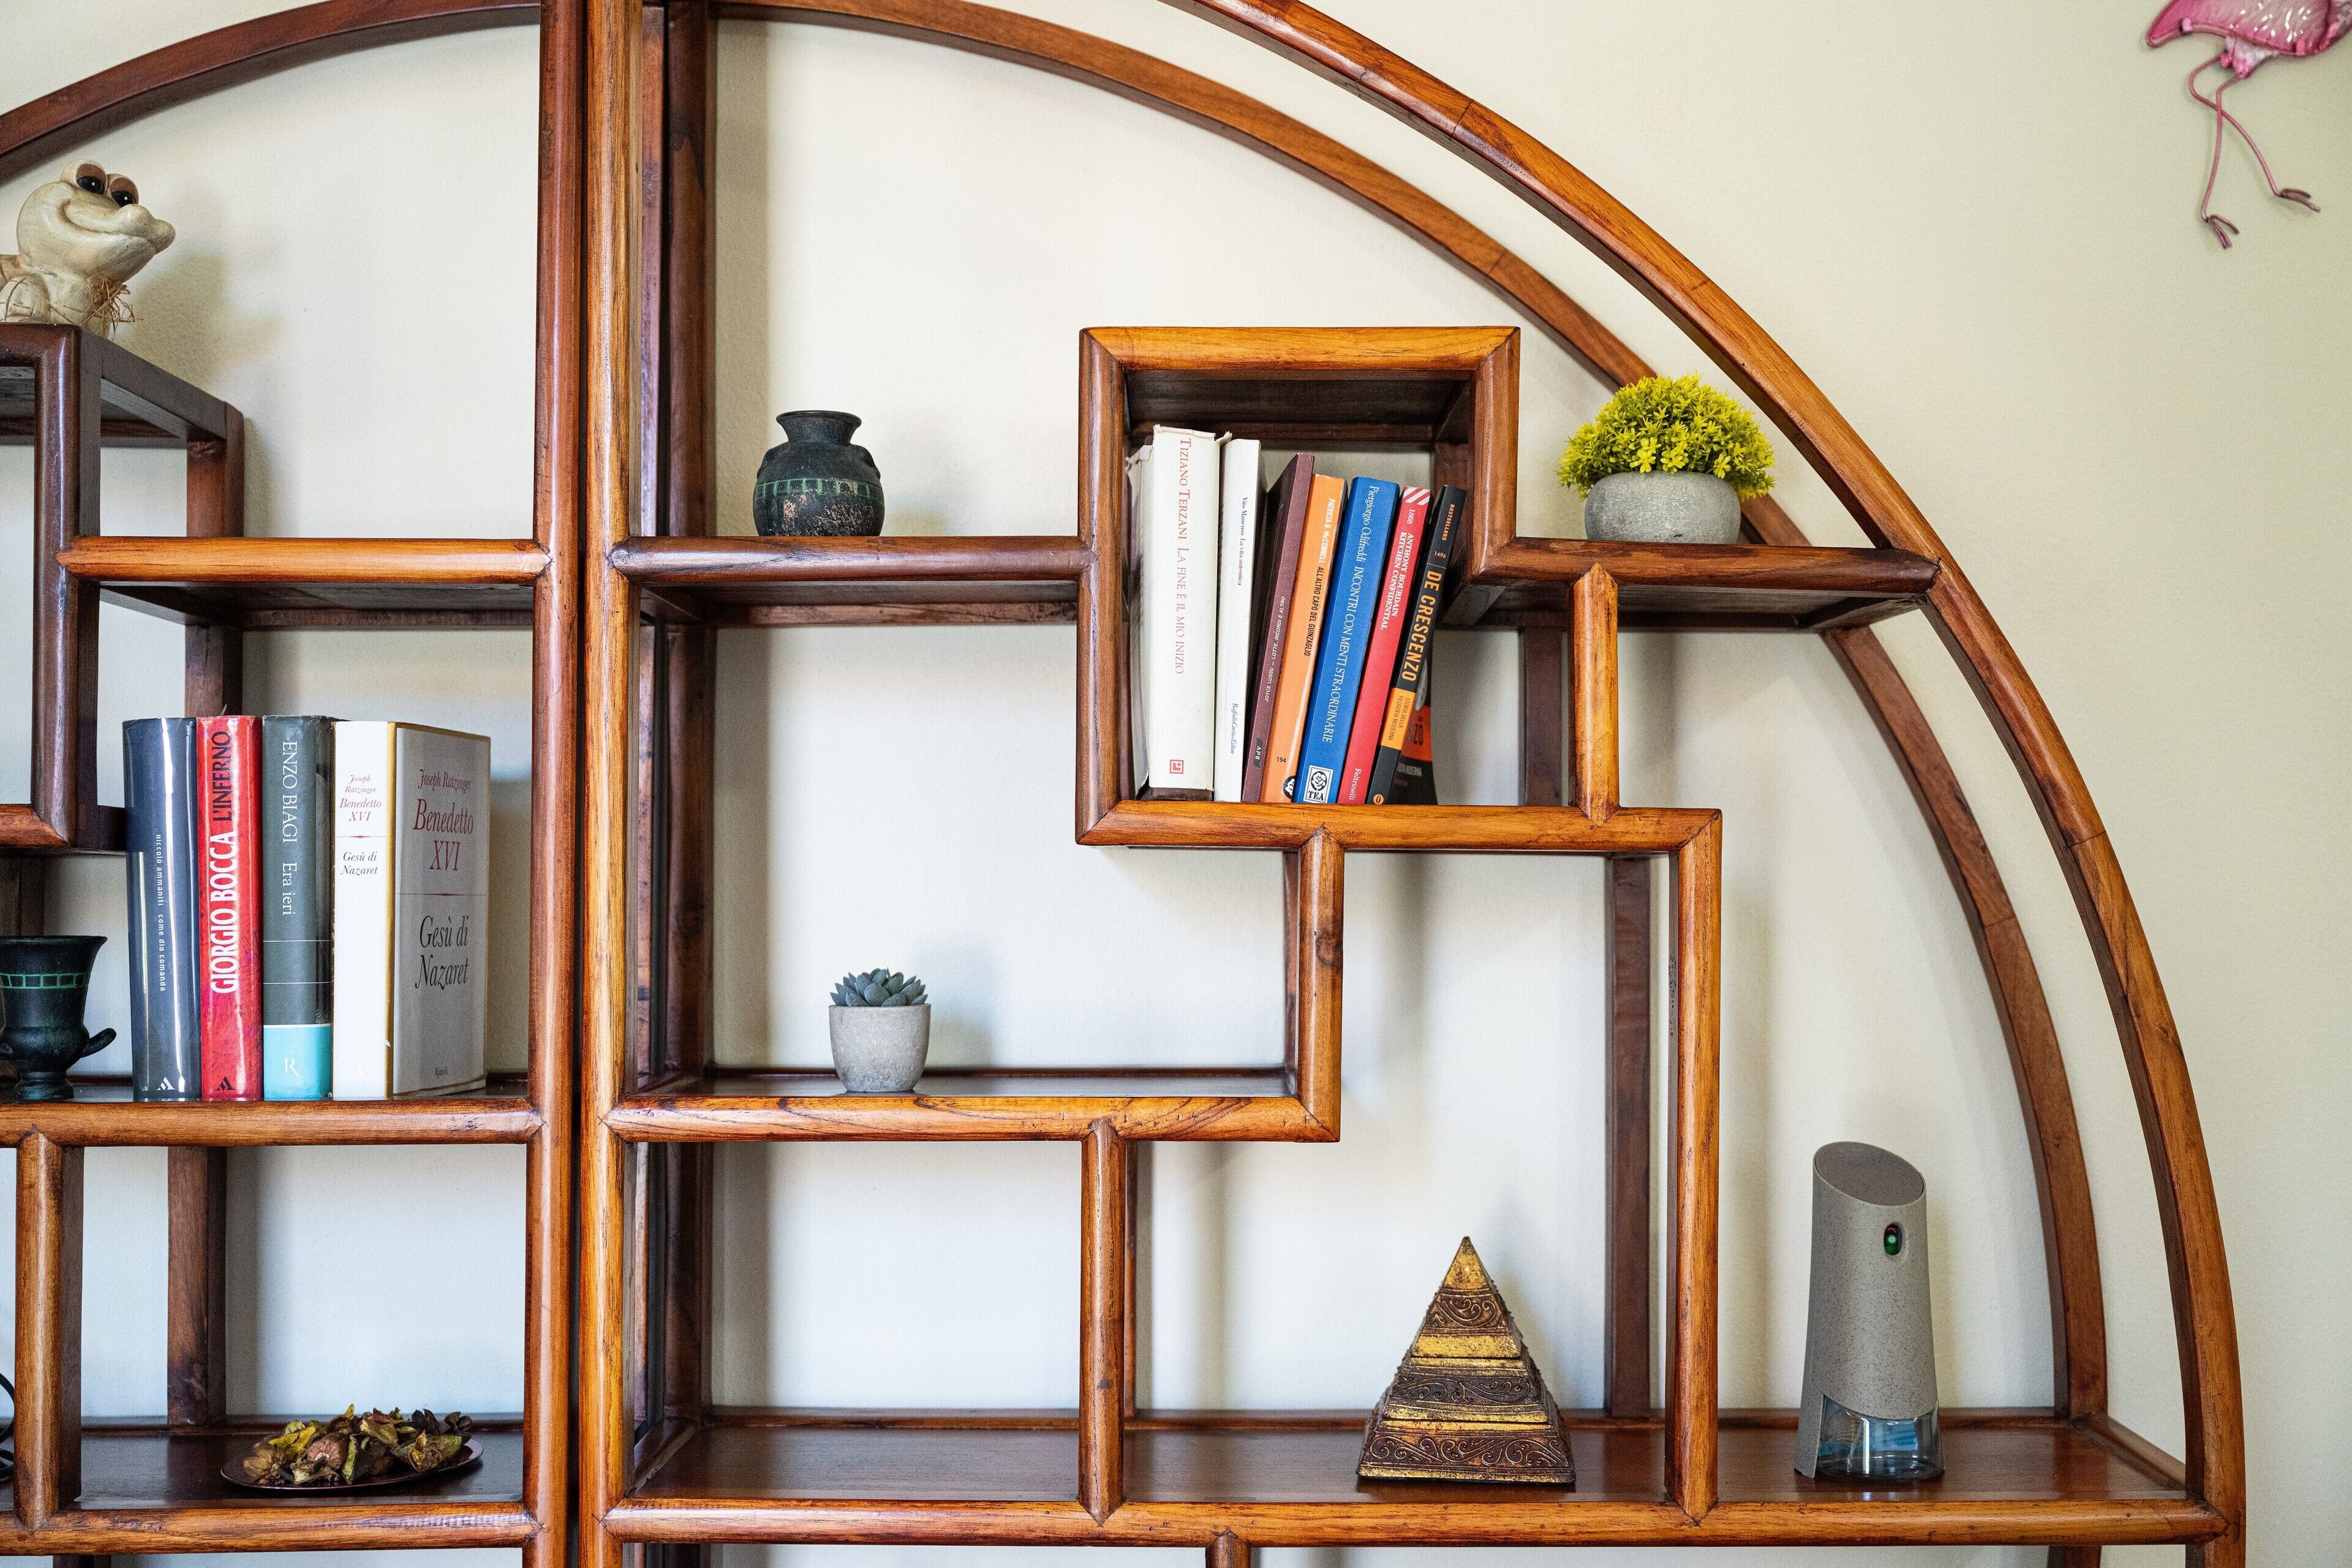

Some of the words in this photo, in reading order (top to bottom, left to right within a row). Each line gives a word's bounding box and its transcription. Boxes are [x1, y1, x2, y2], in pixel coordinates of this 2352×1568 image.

[1179, 438, 1191, 486] TIZIANO
[1178, 489, 1190, 540] TERZANI
[1361, 485, 1379, 525] Piergiorgio
[1407, 509, 1415, 525] 1868
[1442, 503, 1455, 541] BESTSELLERS
[1178, 547, 1189, 563] LA
[1356, 527, 1371, 562] Odifreddi
[1394, 531, 1408, 568] KITCHEN
[1401, 532, 1414, 573] ANTHONY
[1177, 567, 1186, 590] FINE
[1347, 565, 1365, 612] INCONTRI
[1424, 570, 1442, 592] DE
[1176, 603, 1186, 612] IL
[1311, 596, 1320, 611] CAPO
[1381, 570, 1399, 630] CONFIDENTIAL
[1391, 574, 1406, 617] BOURDAIN
[1175, 616, 1185, 638] MIO
[1304, 623, 1316, 657] GUINZAGLIO
[1342, 614, 1355, 636] CON
[1401, 595, 1436, 682] CRESCENZO
[1175, 641, 1185, 674] INIZIO
[1336, 636, 1351, 666] MENTI
[1322, 668, 1345, 744] STRAORDINARIE
[211, 731, 232, 821] L'INFERNO
[282, 741, 298, 789] ENZO
[349, 775, 371, 784] Joseph
[418, 769, 441, 791] Joseph
[1308, 791, 1324, 801] TEA
[1349, 767, 1362, 801] Feltrinelli
[282, 794, 298, 843] BIAGI
[339, 798, 382, 808] Benedetto
[349, 812, 372, 821] XVI
[413, 798, 474, 835] Benedetto
[209, 831, 238, 902] BOCCA
[341, 865, 378, 876] Nazaret
[343, 851, 364, 861] Gesù
[368, 851, 377, 861] di
[429, 840, 461, 871] XVI
[282, 862, 297, 886] Era
[282, 892, 295, 915] ieri
[420, 915, 453, 948] Gesù
[456, 915, 469, 946] di
[209, 908, 239, 993] GIORGIO
[415, 954, 469, 990] Nazaret
[284, 1057, 303, 1078] R
